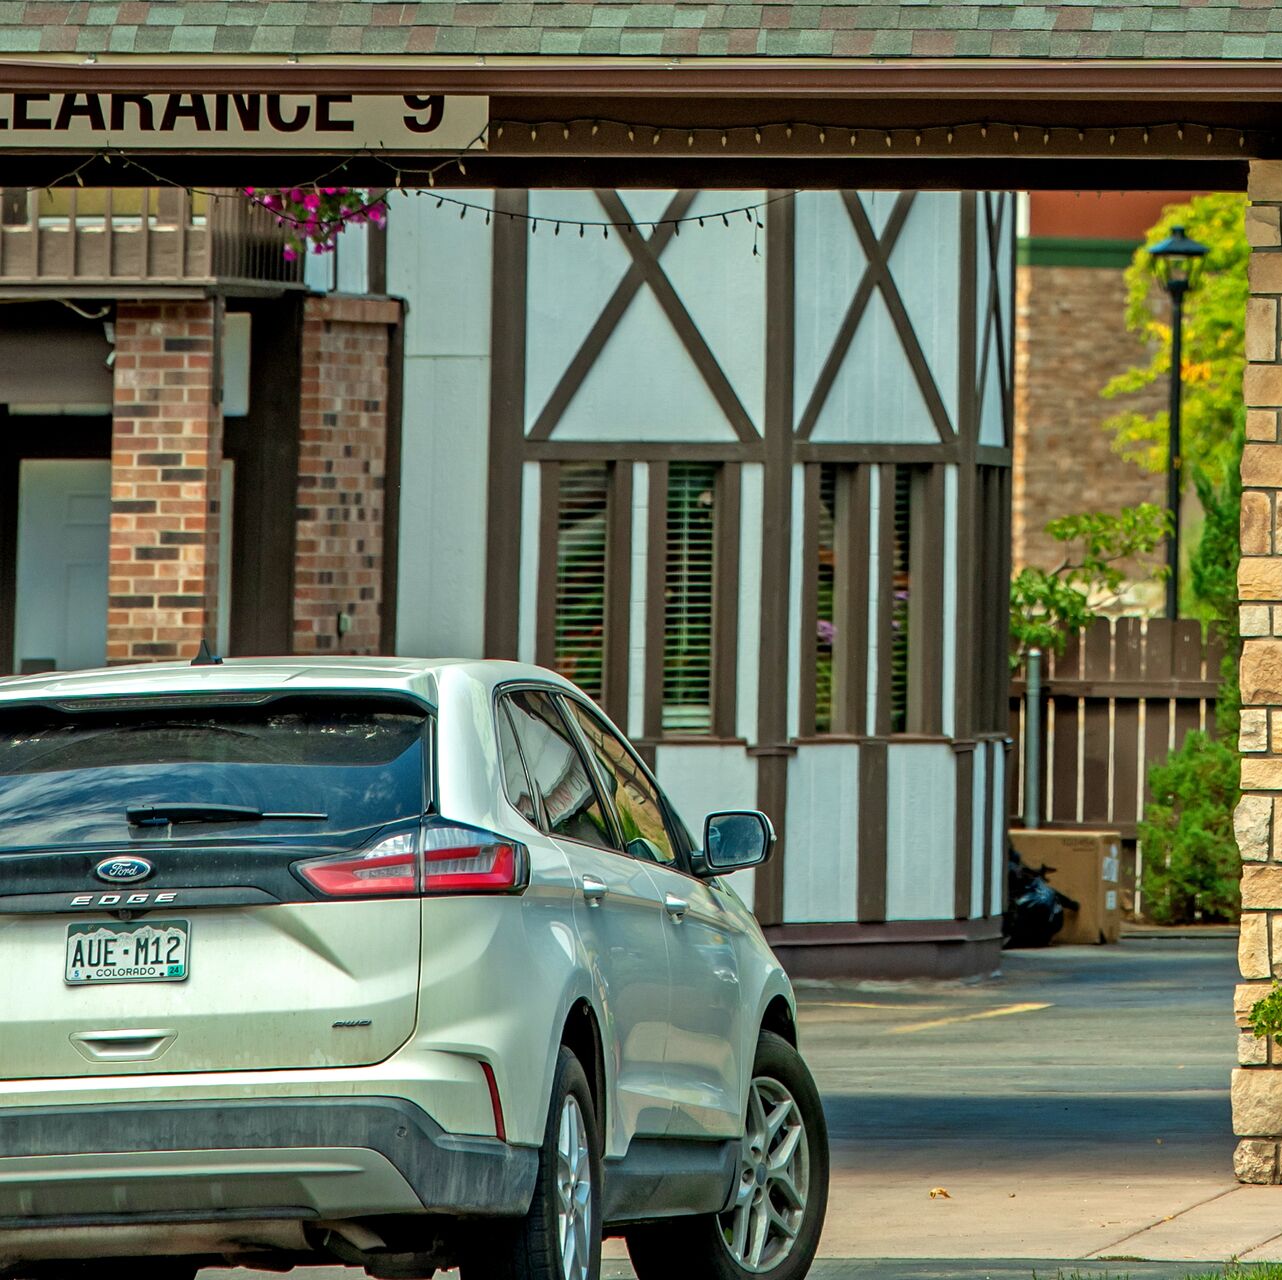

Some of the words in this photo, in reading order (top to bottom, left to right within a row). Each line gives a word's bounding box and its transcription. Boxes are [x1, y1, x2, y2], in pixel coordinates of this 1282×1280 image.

[0, 93, 355, 132] EARANCE
[109, 861, 138, 876] Ford
[70, 892, 177, 906] EDGE
[96, 966, 156, 977] COLORADO
[169, 966, 179, 975] 24
